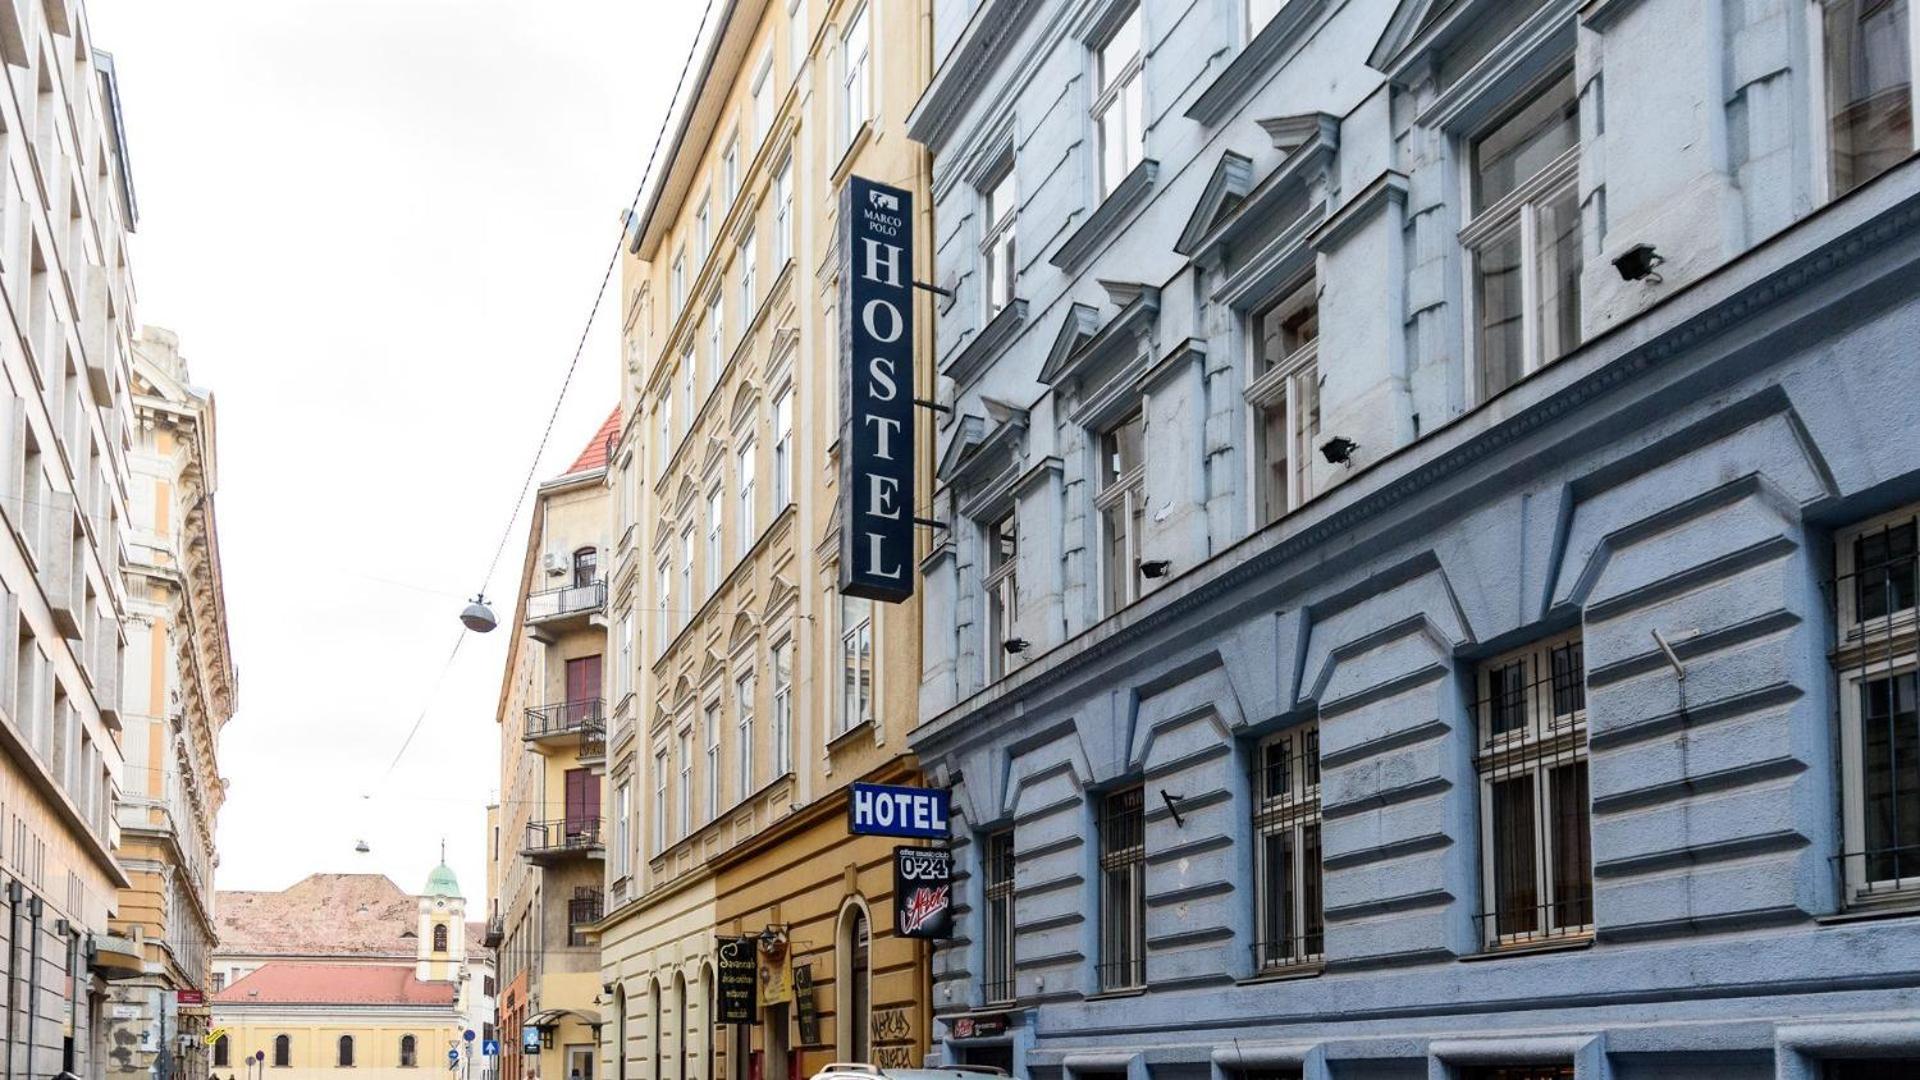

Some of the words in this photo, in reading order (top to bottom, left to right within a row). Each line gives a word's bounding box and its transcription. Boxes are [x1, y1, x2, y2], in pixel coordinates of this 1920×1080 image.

[864, 208, 902, 228] MARCO
[869, 221, 897, 236] POLO
[861, 237, 904, 579] HOSTEL
[855, 790, 946, 830] HOTEL
[901, 857, 949, 880] 0-24
